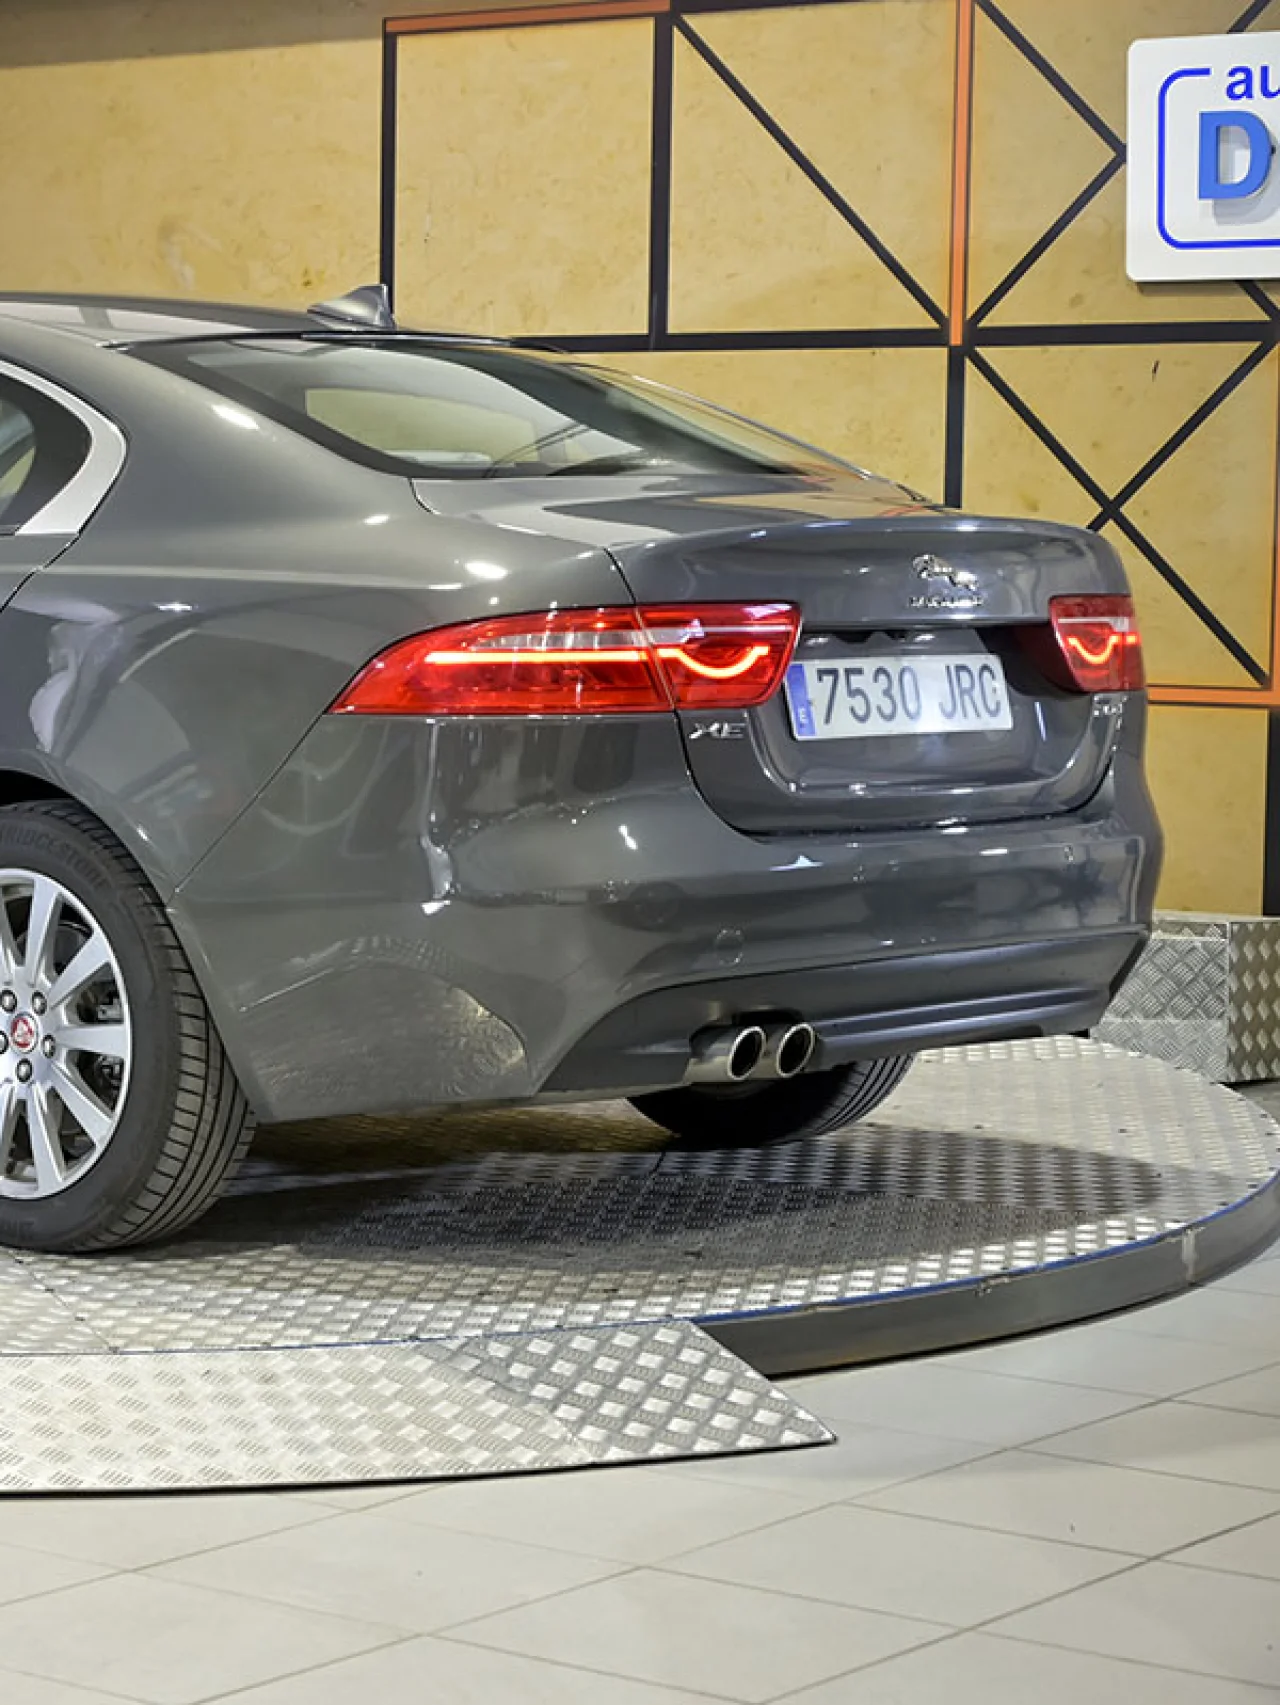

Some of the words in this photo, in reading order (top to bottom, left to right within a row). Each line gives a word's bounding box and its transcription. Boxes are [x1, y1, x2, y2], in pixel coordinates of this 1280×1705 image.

[816, 665, 922, 724] 7530
[938, 662, 1002, 720] JRC
[688, 721, 746, 739] XE
